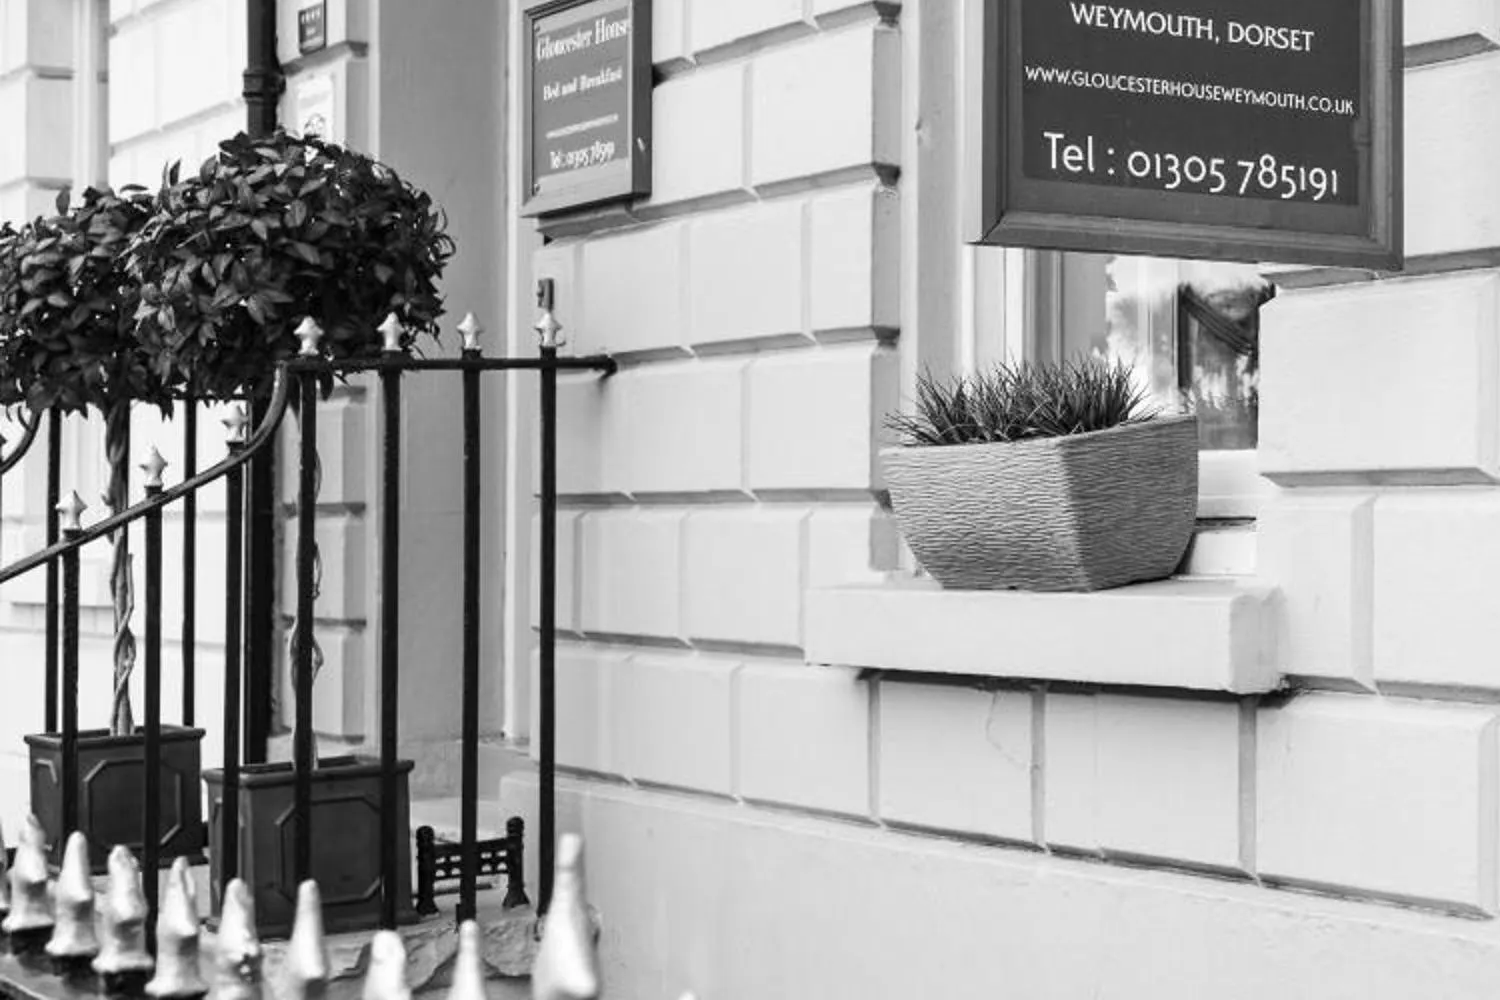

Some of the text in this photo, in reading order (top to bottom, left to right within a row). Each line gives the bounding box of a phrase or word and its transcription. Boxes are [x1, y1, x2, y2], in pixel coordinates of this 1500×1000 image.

[1069, 2, 1315, 51] WEYMOUTH, DORSET
[1024, 65, 1355, 116] WWW.GLOUCESTERHOUSEWEYMOUTH.CO.UK
[1043, 131, 1095, 173] Tel
[1127, 150, 1226, 193] 01305
[1237, 154, 1338, 200] 785191
